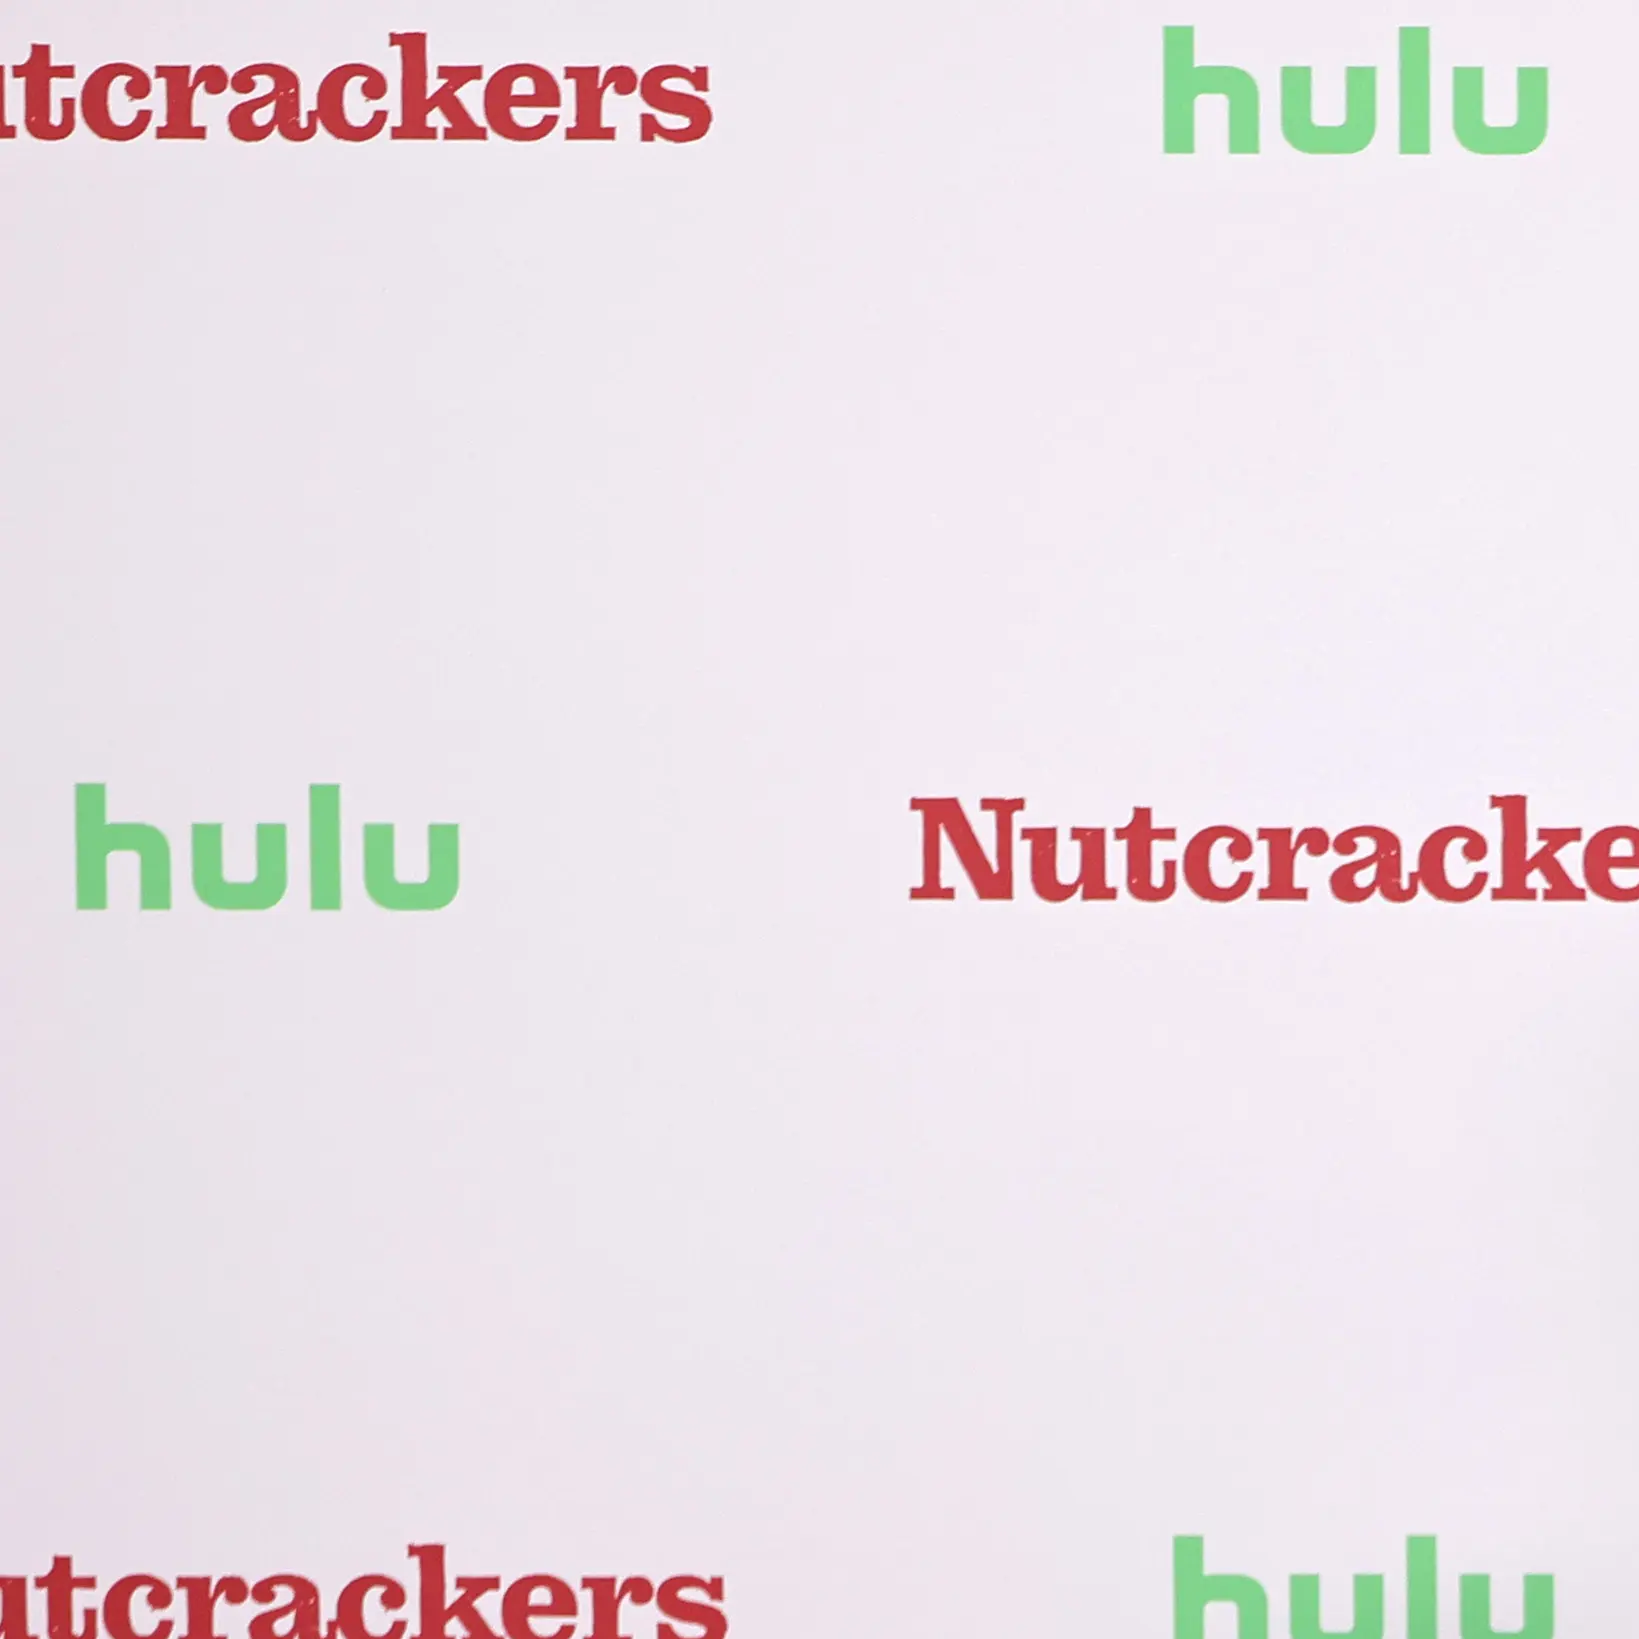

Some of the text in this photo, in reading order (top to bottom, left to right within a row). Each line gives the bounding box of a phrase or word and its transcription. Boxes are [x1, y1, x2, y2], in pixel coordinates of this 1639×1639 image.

[0, 33, 713, 143] tcrackers
[1163, 25, 1549, 155] hulu
[75, 783, 460, 912] hulu
